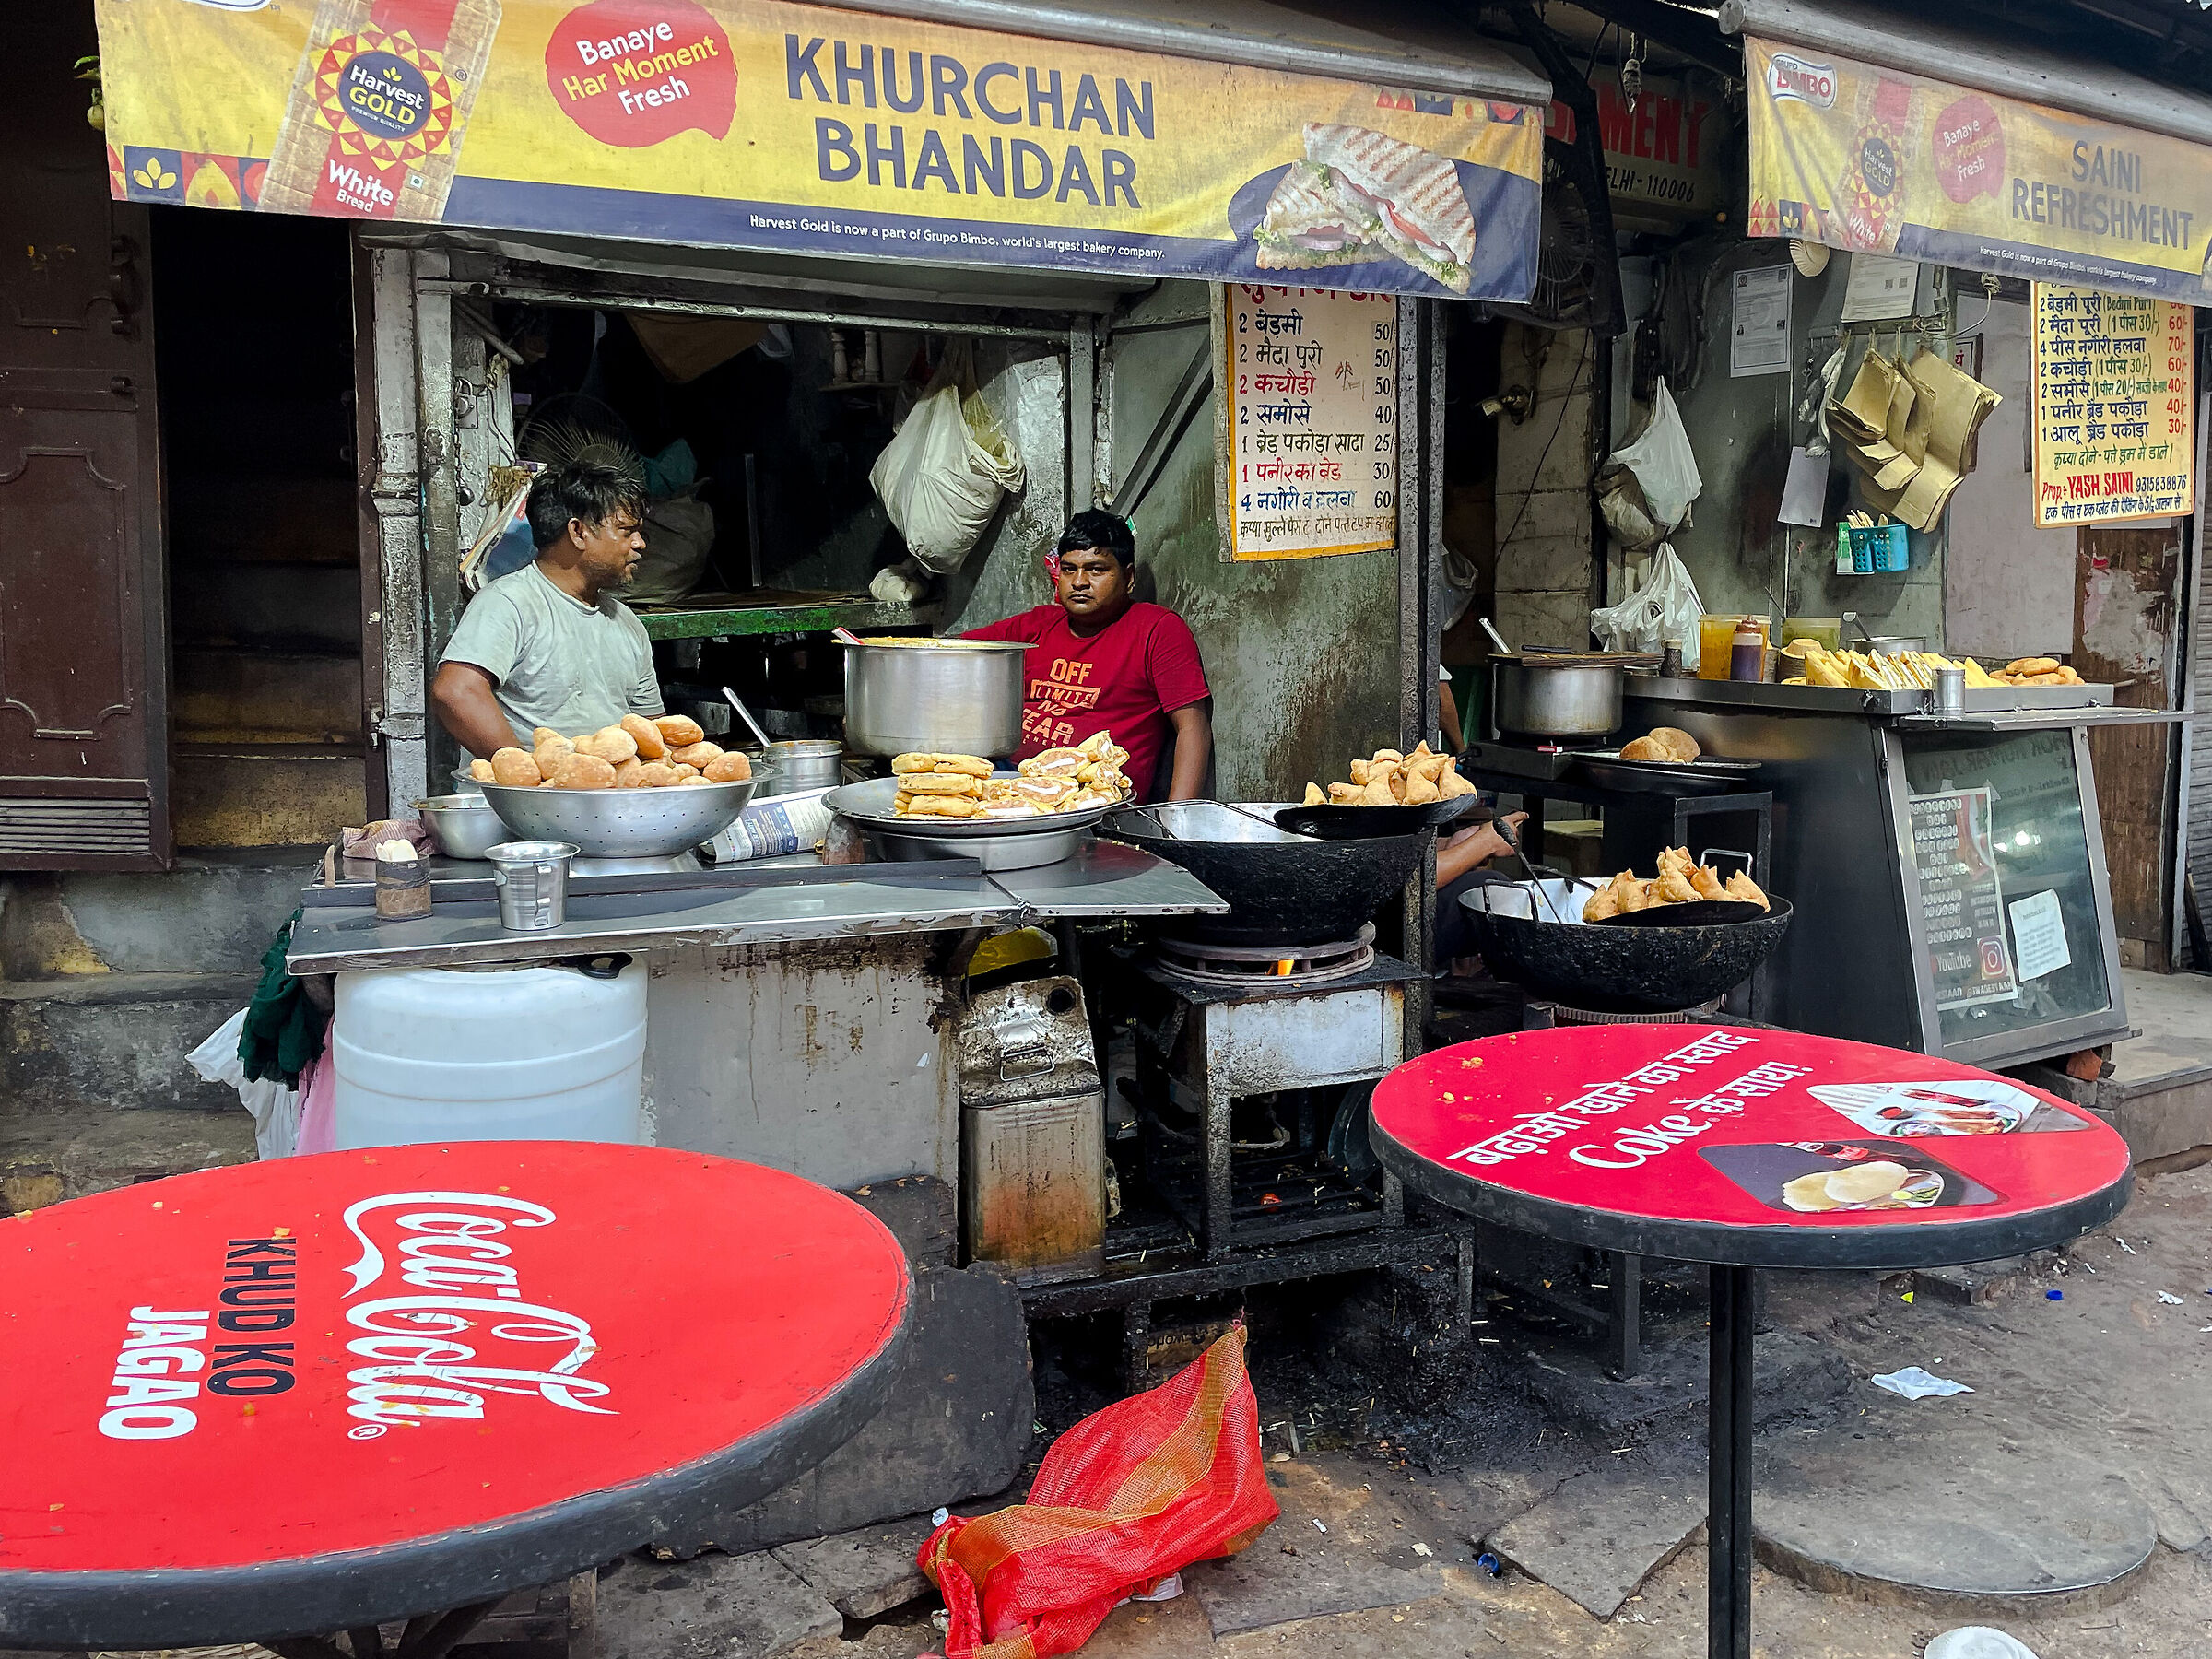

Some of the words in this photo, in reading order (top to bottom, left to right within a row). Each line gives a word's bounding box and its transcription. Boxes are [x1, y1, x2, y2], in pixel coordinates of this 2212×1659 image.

[576, 22, 674, 65] Banaye
[562, 73, 608, 101] Har
[612, 35, 719, 86] Moment
[349, 65, 426, 111] Harvest
[618, 75, 691, 115] Fresh
[784, 33, 1155, 140] KHURCHAN
[349, 87, 416, 124] GOLD
[351, 105, 379, 122] PREMIUM
[380, 117, 406, 133] QUALITY
[1943, 120, 1981, 147] Banaye
[814, 116, 1142, 209] BHANDAR
[1864, 147, 1893, 177] Harvest
[1865, 161, 1891, 187] GOLD
[1957, 155, 1985, 182] Fresh
[2072, 140, 2141, 194] SAINI
[328, 159, 394, 206] White
[335, 189, 375, 213] Bread
[2012, 177, 2194, 250] REFRESHMENT
[749, 214, 798, 230] Harvest
[800, 218, 829, 233] Gold
[831, 220, 841, 235] is
[844, 225, 868, 236] now
[871, 229, 879, 238] a
[881, 228, 907, 241] part
[909, 229, 921, 241] of
[923, 229, 959, 245] Grupo
[1043, 237, 1080, 253] largest
[1082, 240, 1116, 257] bakery
[1117, 244, 1165, 261] company.
[1849, 212, 1877, 244] White
[1979, 245, 2001, 258] Harvest
[2001, 249, 2015, 261] Gold
[2015, 253, 2020, 261] is
[2020, 253, 2031, 263] now
[2035, 257, 2047, 266] part
[2040, 298, 2045, 312] 2
[2080, 291, 2102, 315] पूरी
[1239, 312, 1248, 334] 2
[1254, 307, 1304, 340] बेड़मी
[2040, 318, 2045, 334] 2
[2078, 313, 2102, 337] पूरी
[2119, 312, 2138, 333] पीस
[2168, 314, 2188, 334] 60/-
[1239, 343, 1248, 364] 2
[1255, 335, 1291, 367] मैदा
[1295, 339, 1324, 370] पुरी
[2040, 340, 2046, 357] 4
[2049, 335, 2075, 357] पीस
[2112, 337, 2147, 358] हलवा
[2168, 335, 2186, 353] 70/-
[2041, 361, 2047, 378] 2
[2105, 356, 2128, 377] पीस
[2168, 356, 2188, 374] 60/-
[1239, 374, 1249, 394] 2
[2041, 383, 2048, 399] 2
[2100, 378, 2114, 397] पीस
[2168, 376, 2187, 394] 40/-
[1240, 406, 1249, 425] 2
[1256, 397, 1312, 426] समोसे
[2041, 406, 2046, 421] 1
[2050, 399, 2085, 420] पनीर
[2166, 396, 2187, 416] 40/-
[1241, 435, 1248, 453] 1
[1335, 432, 1366, 456] सादा
[2041, 427, 2047, 442] 1
[2050, 424, 2083, 446] आलू
[2168, 417, 2187, 436] 30/-
[2137, 441, 2147, 464] में
[1242, 464, 1249, 483] 1
[1256, 456, 1294, 484] पनीर
[1295, 463, 1318, 482] का
[2066, 473, 2100, 500] YASH
[2103, 471, 2134, 497] SAINI
[1241, 493, 1253, 512] 4
[1050, 658, 1093, 685] OFF
[1037, 700, 1067, 716] NO
[1936, 951, 1971, 972] YouTube
[1446, 1112, 1591, 1165] बढ़ाओ
[1557, 1081, 1655, 1116] खाने
[1622, 1062, 1696, 1086] का
[1662, 1030, 1761, 1064] स्वाद
[1569, 1113, 1713, 1169] Coke
[1669, 1093, 1746, 1115] के
[1715, 1061, 1815, 1098] साथ!
[218, 1238, 297, 1332] KHUD
[98, 1305, 210, 1440] JAGAO
[206, 1342, 296, 1396] KO
